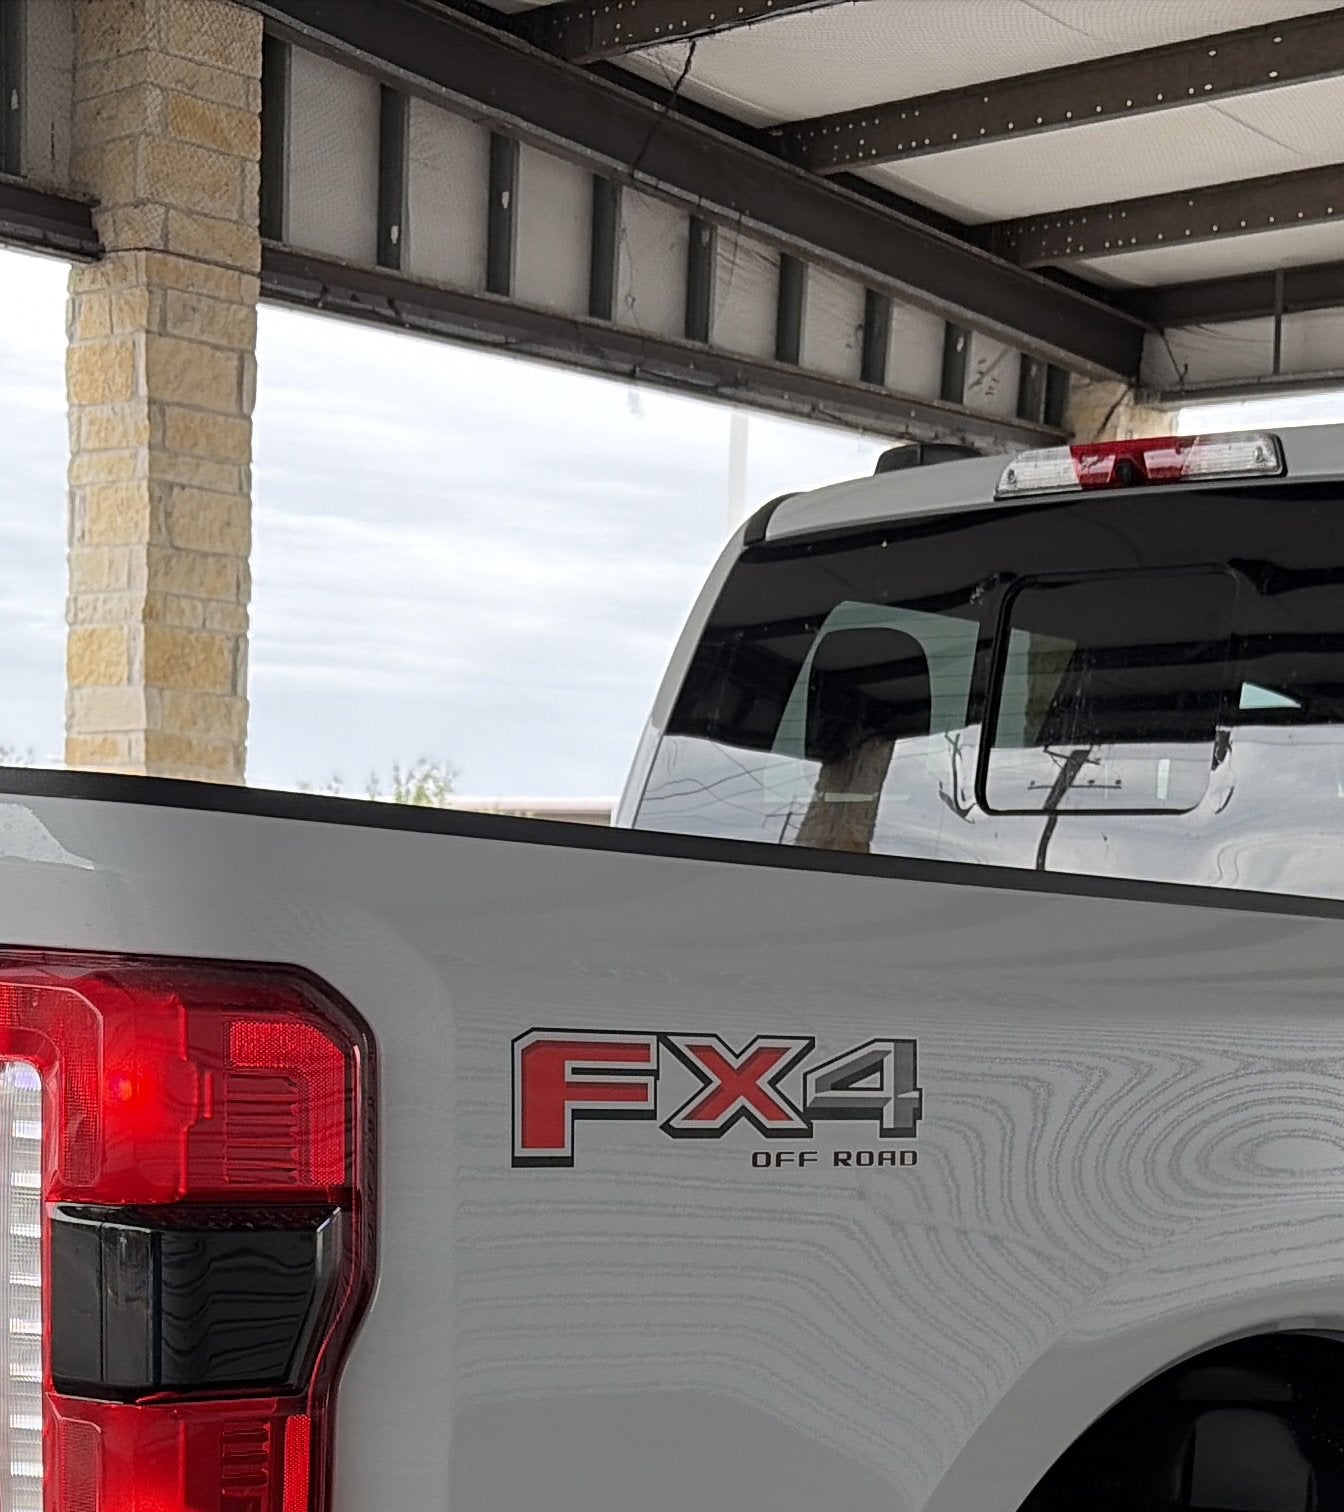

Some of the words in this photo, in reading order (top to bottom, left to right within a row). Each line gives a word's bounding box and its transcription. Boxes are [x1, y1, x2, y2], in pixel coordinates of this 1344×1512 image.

[511, 1027, 923, 1168] FX4
[751, 1150, 819, 1168] OFF
[833, 1150, 919, 1168] ROAD
